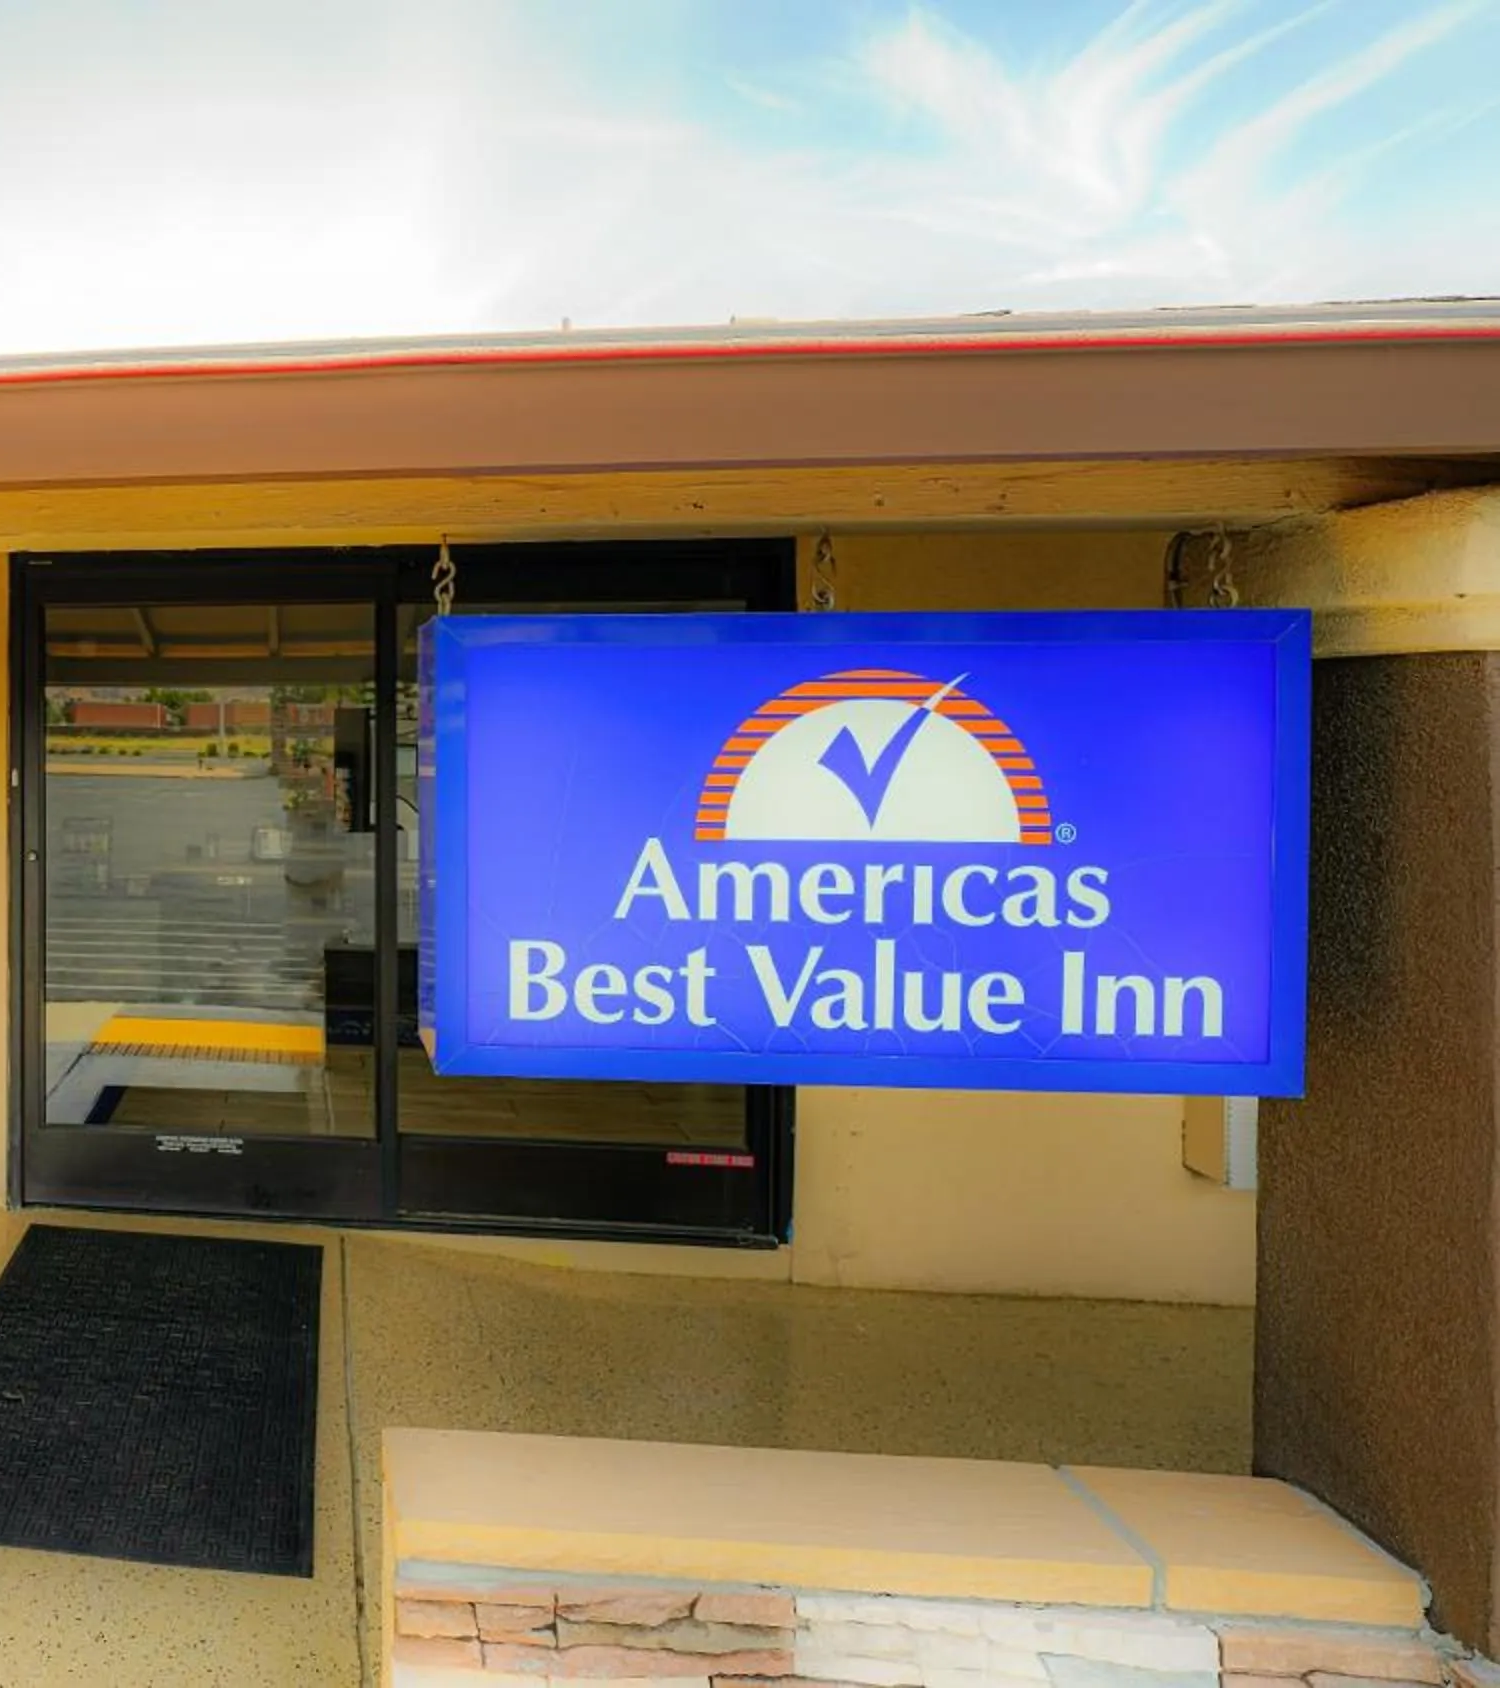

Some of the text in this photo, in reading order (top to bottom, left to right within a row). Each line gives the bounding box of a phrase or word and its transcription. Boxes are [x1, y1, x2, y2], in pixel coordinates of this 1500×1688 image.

[613, 837, 1111, 927] Americas
[508, 939, 1224, 1037] Best Value Inn
